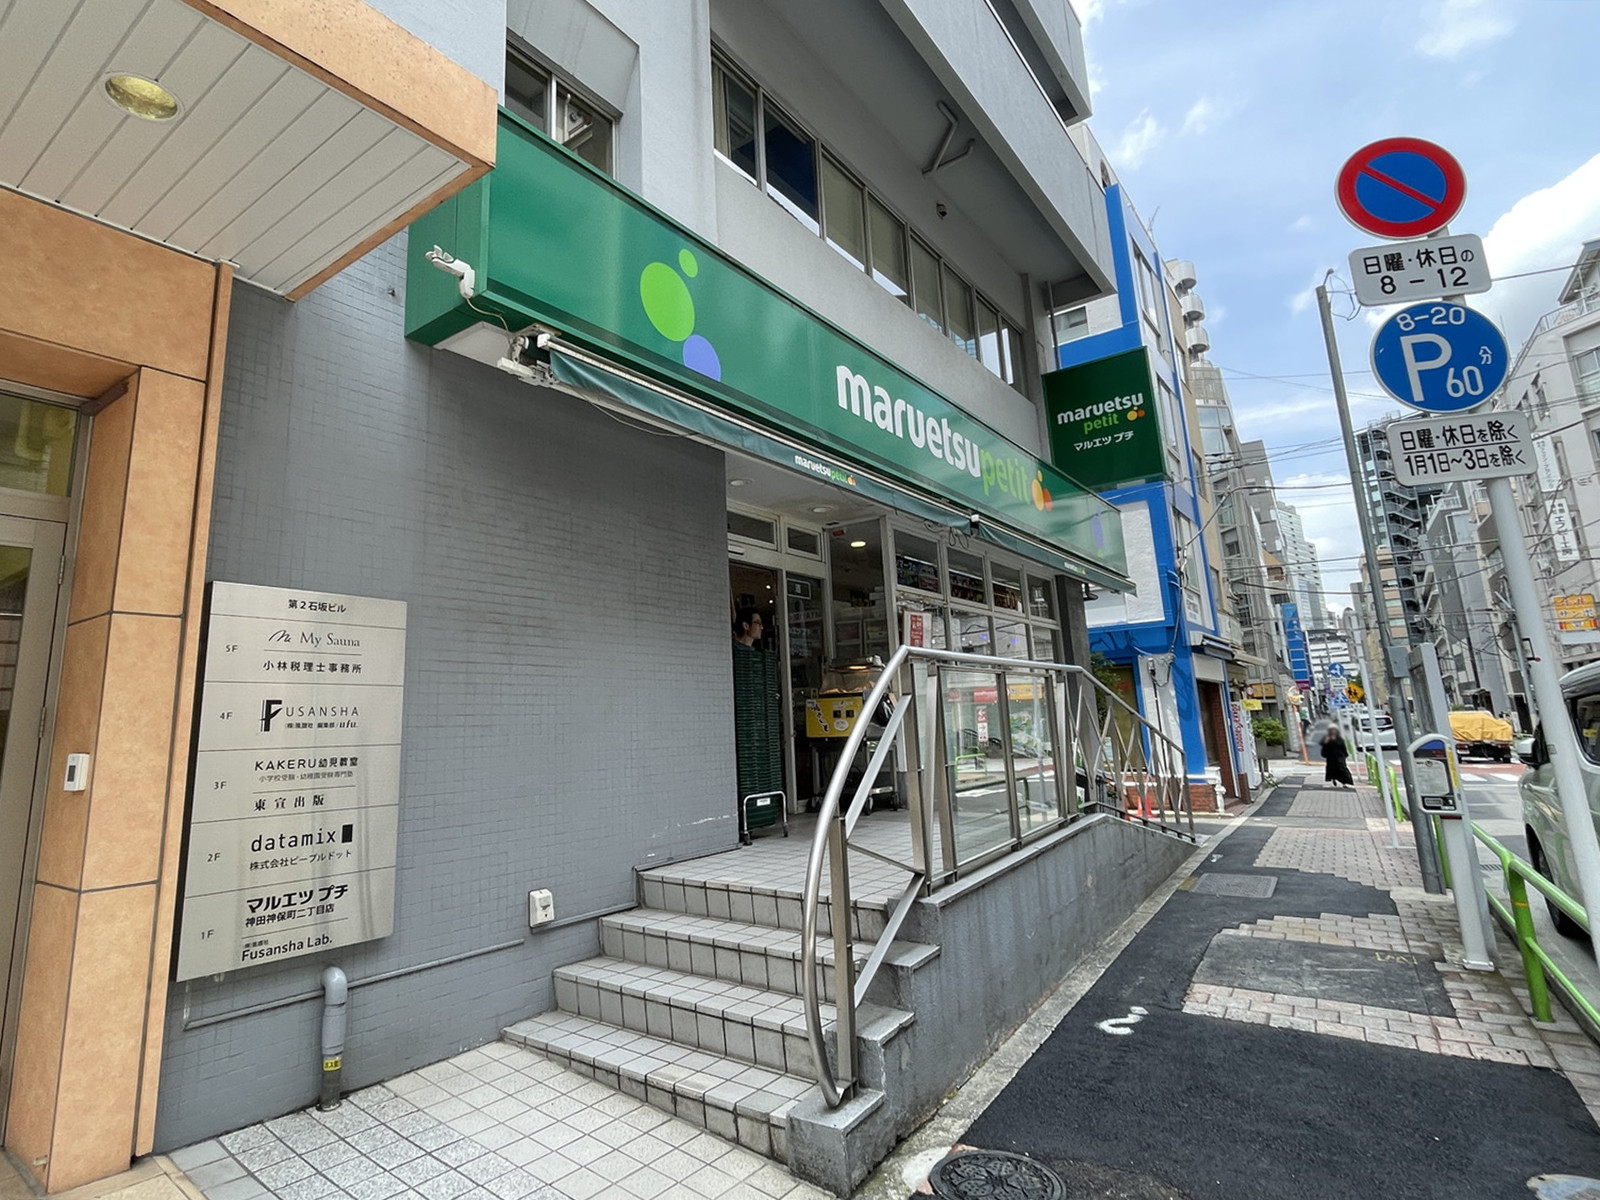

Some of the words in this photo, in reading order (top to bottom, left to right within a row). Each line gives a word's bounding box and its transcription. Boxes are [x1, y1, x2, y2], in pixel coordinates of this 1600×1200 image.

[1396, 306, 1466, 331] 8-20
[1400, 333, 1453, 402] P
[1056, 392, 1144, 425] maruetsu
[1083, 413, 1119, 435] petit
[1400, 420, 1519, 450] 日曜・休日を除く
[288, 598, 347, 613] 第2石坂ビル
[225, 644, 238, 653] 5F
[300, 631, 322, 648] My
[326, 632, 361, 648] Sauna
[263, 660, 362, 674] 小林税理士事務所
[219, 711, 233, 720] 4F
[213, 780, 227, 790] 3F
[250, 828, 337, 853] datamix
[207, 852, 221, 863] 2F
[244, 903, 335, 928] 神田神保町二丁目店
[200, 929, 214, 940] 1F
[241, 940, 304, 962] Fusansha
[307, 933, 333, 949] Lab.
